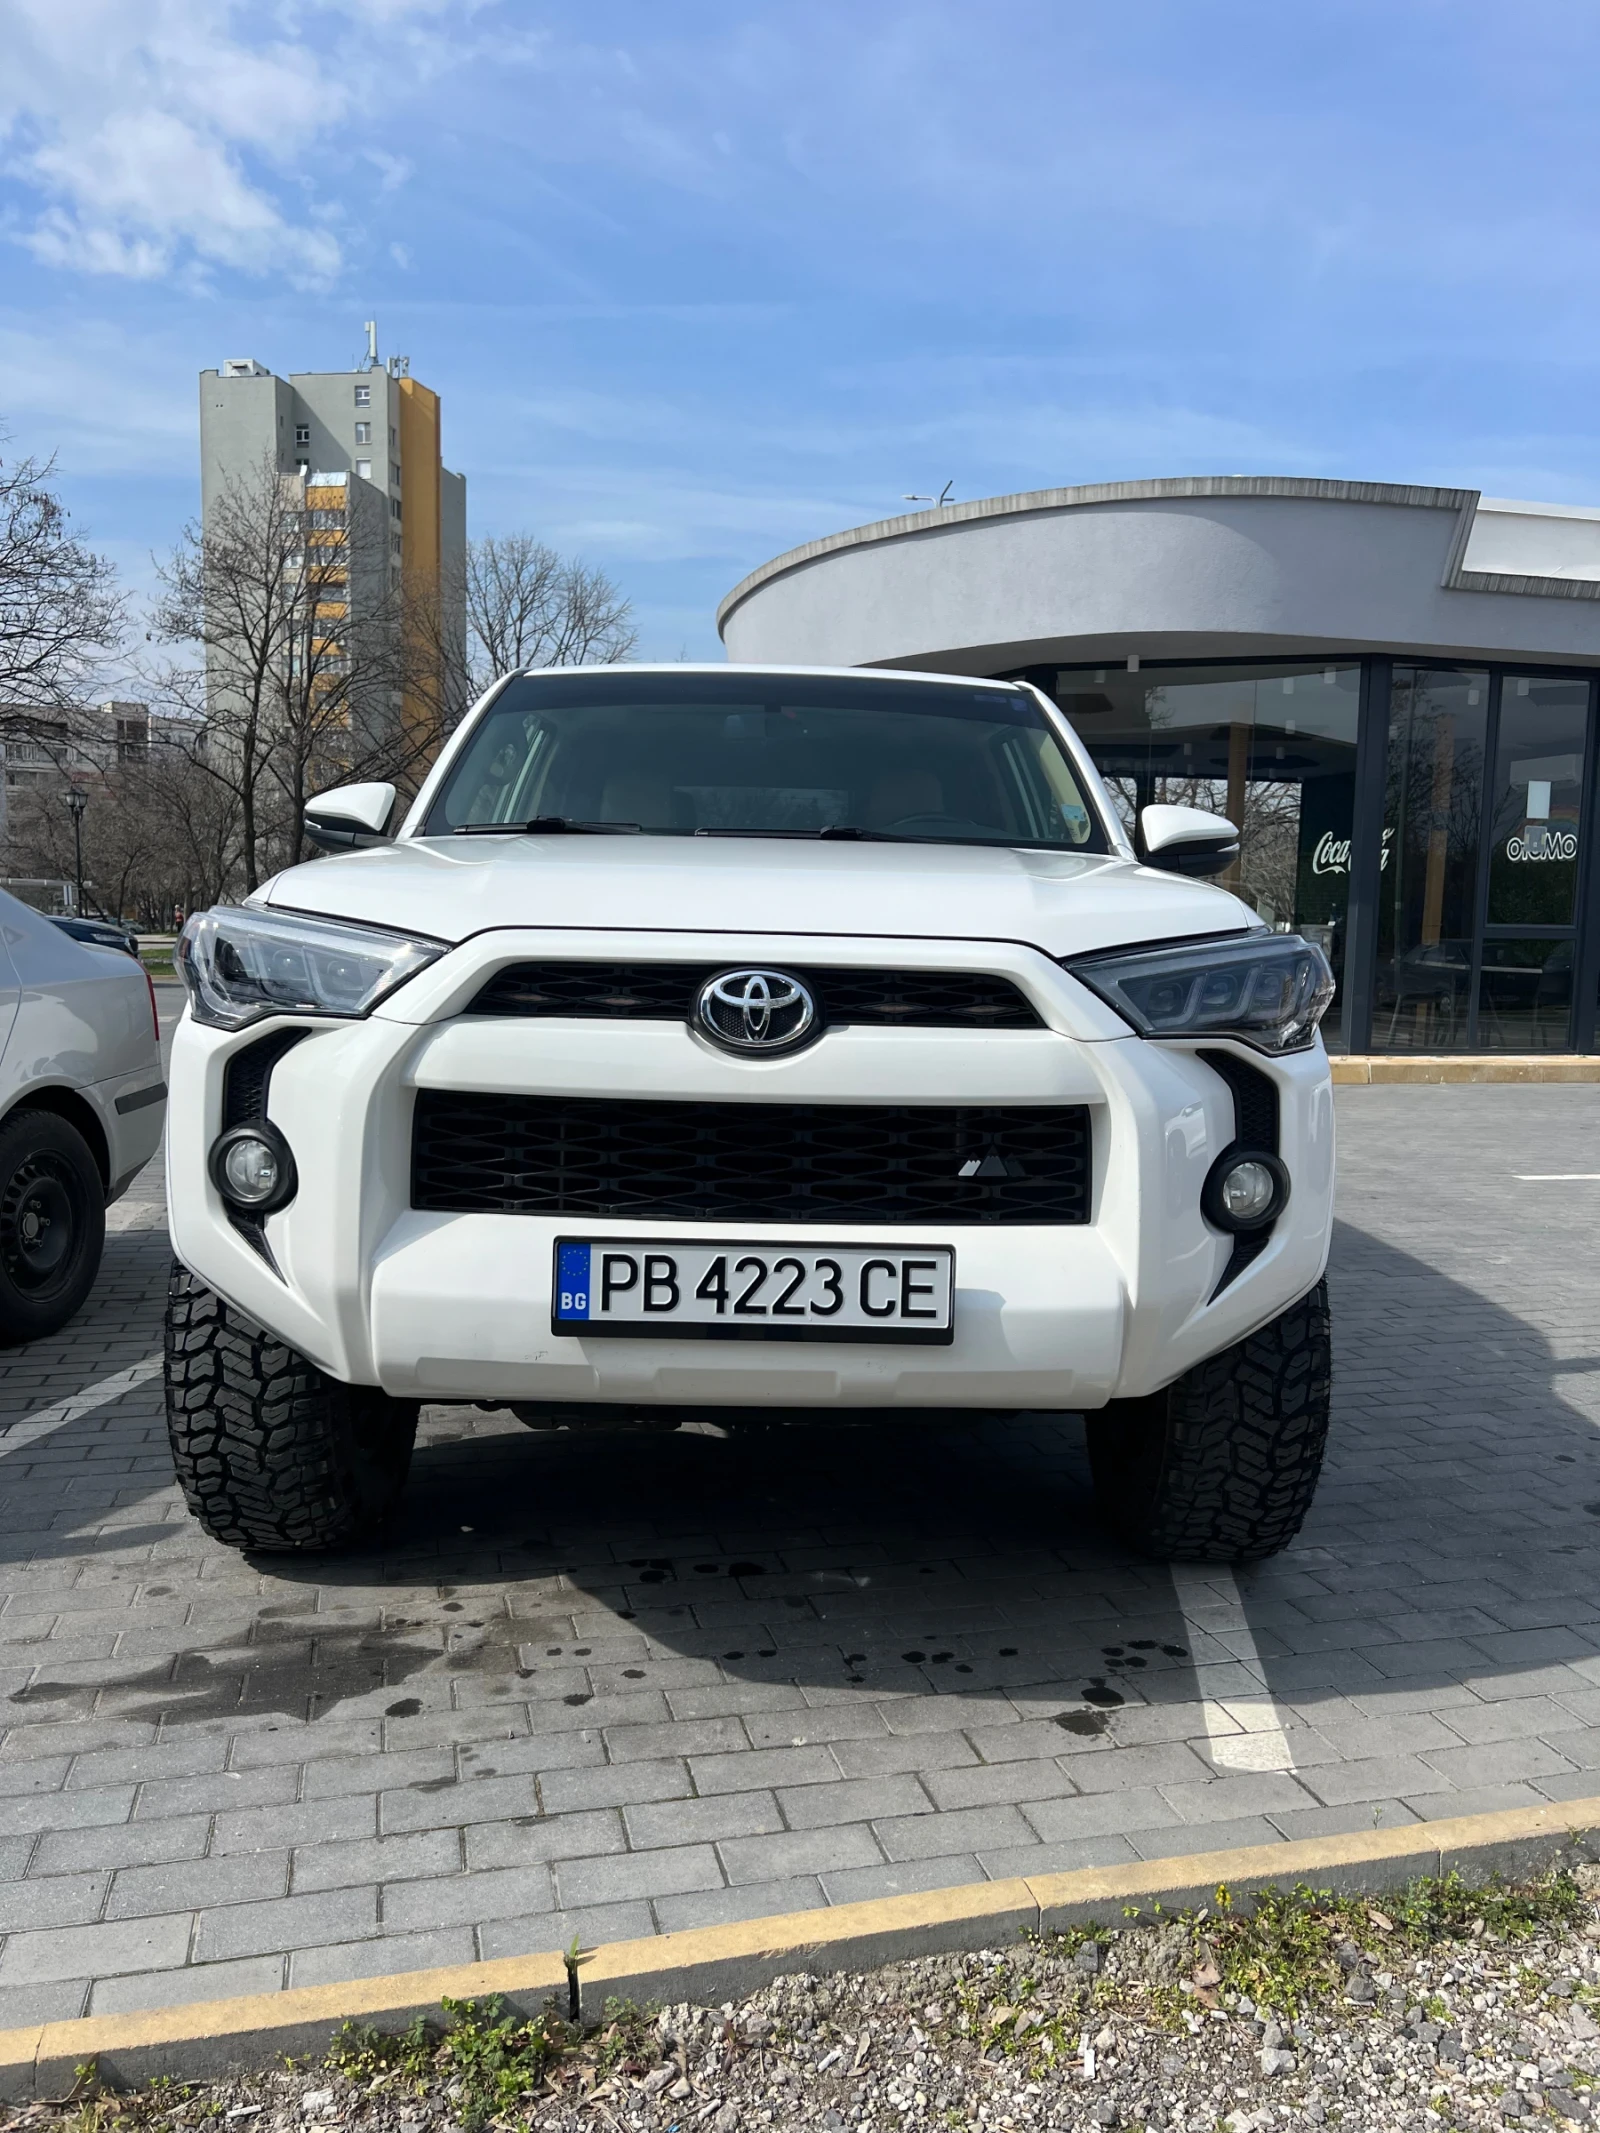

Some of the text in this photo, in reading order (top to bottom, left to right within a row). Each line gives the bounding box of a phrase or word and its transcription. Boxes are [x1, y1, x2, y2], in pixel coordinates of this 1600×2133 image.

[560, 1292, 587, 1310] BG
[601, 1253, 937, 1318] PB 4223 CE
